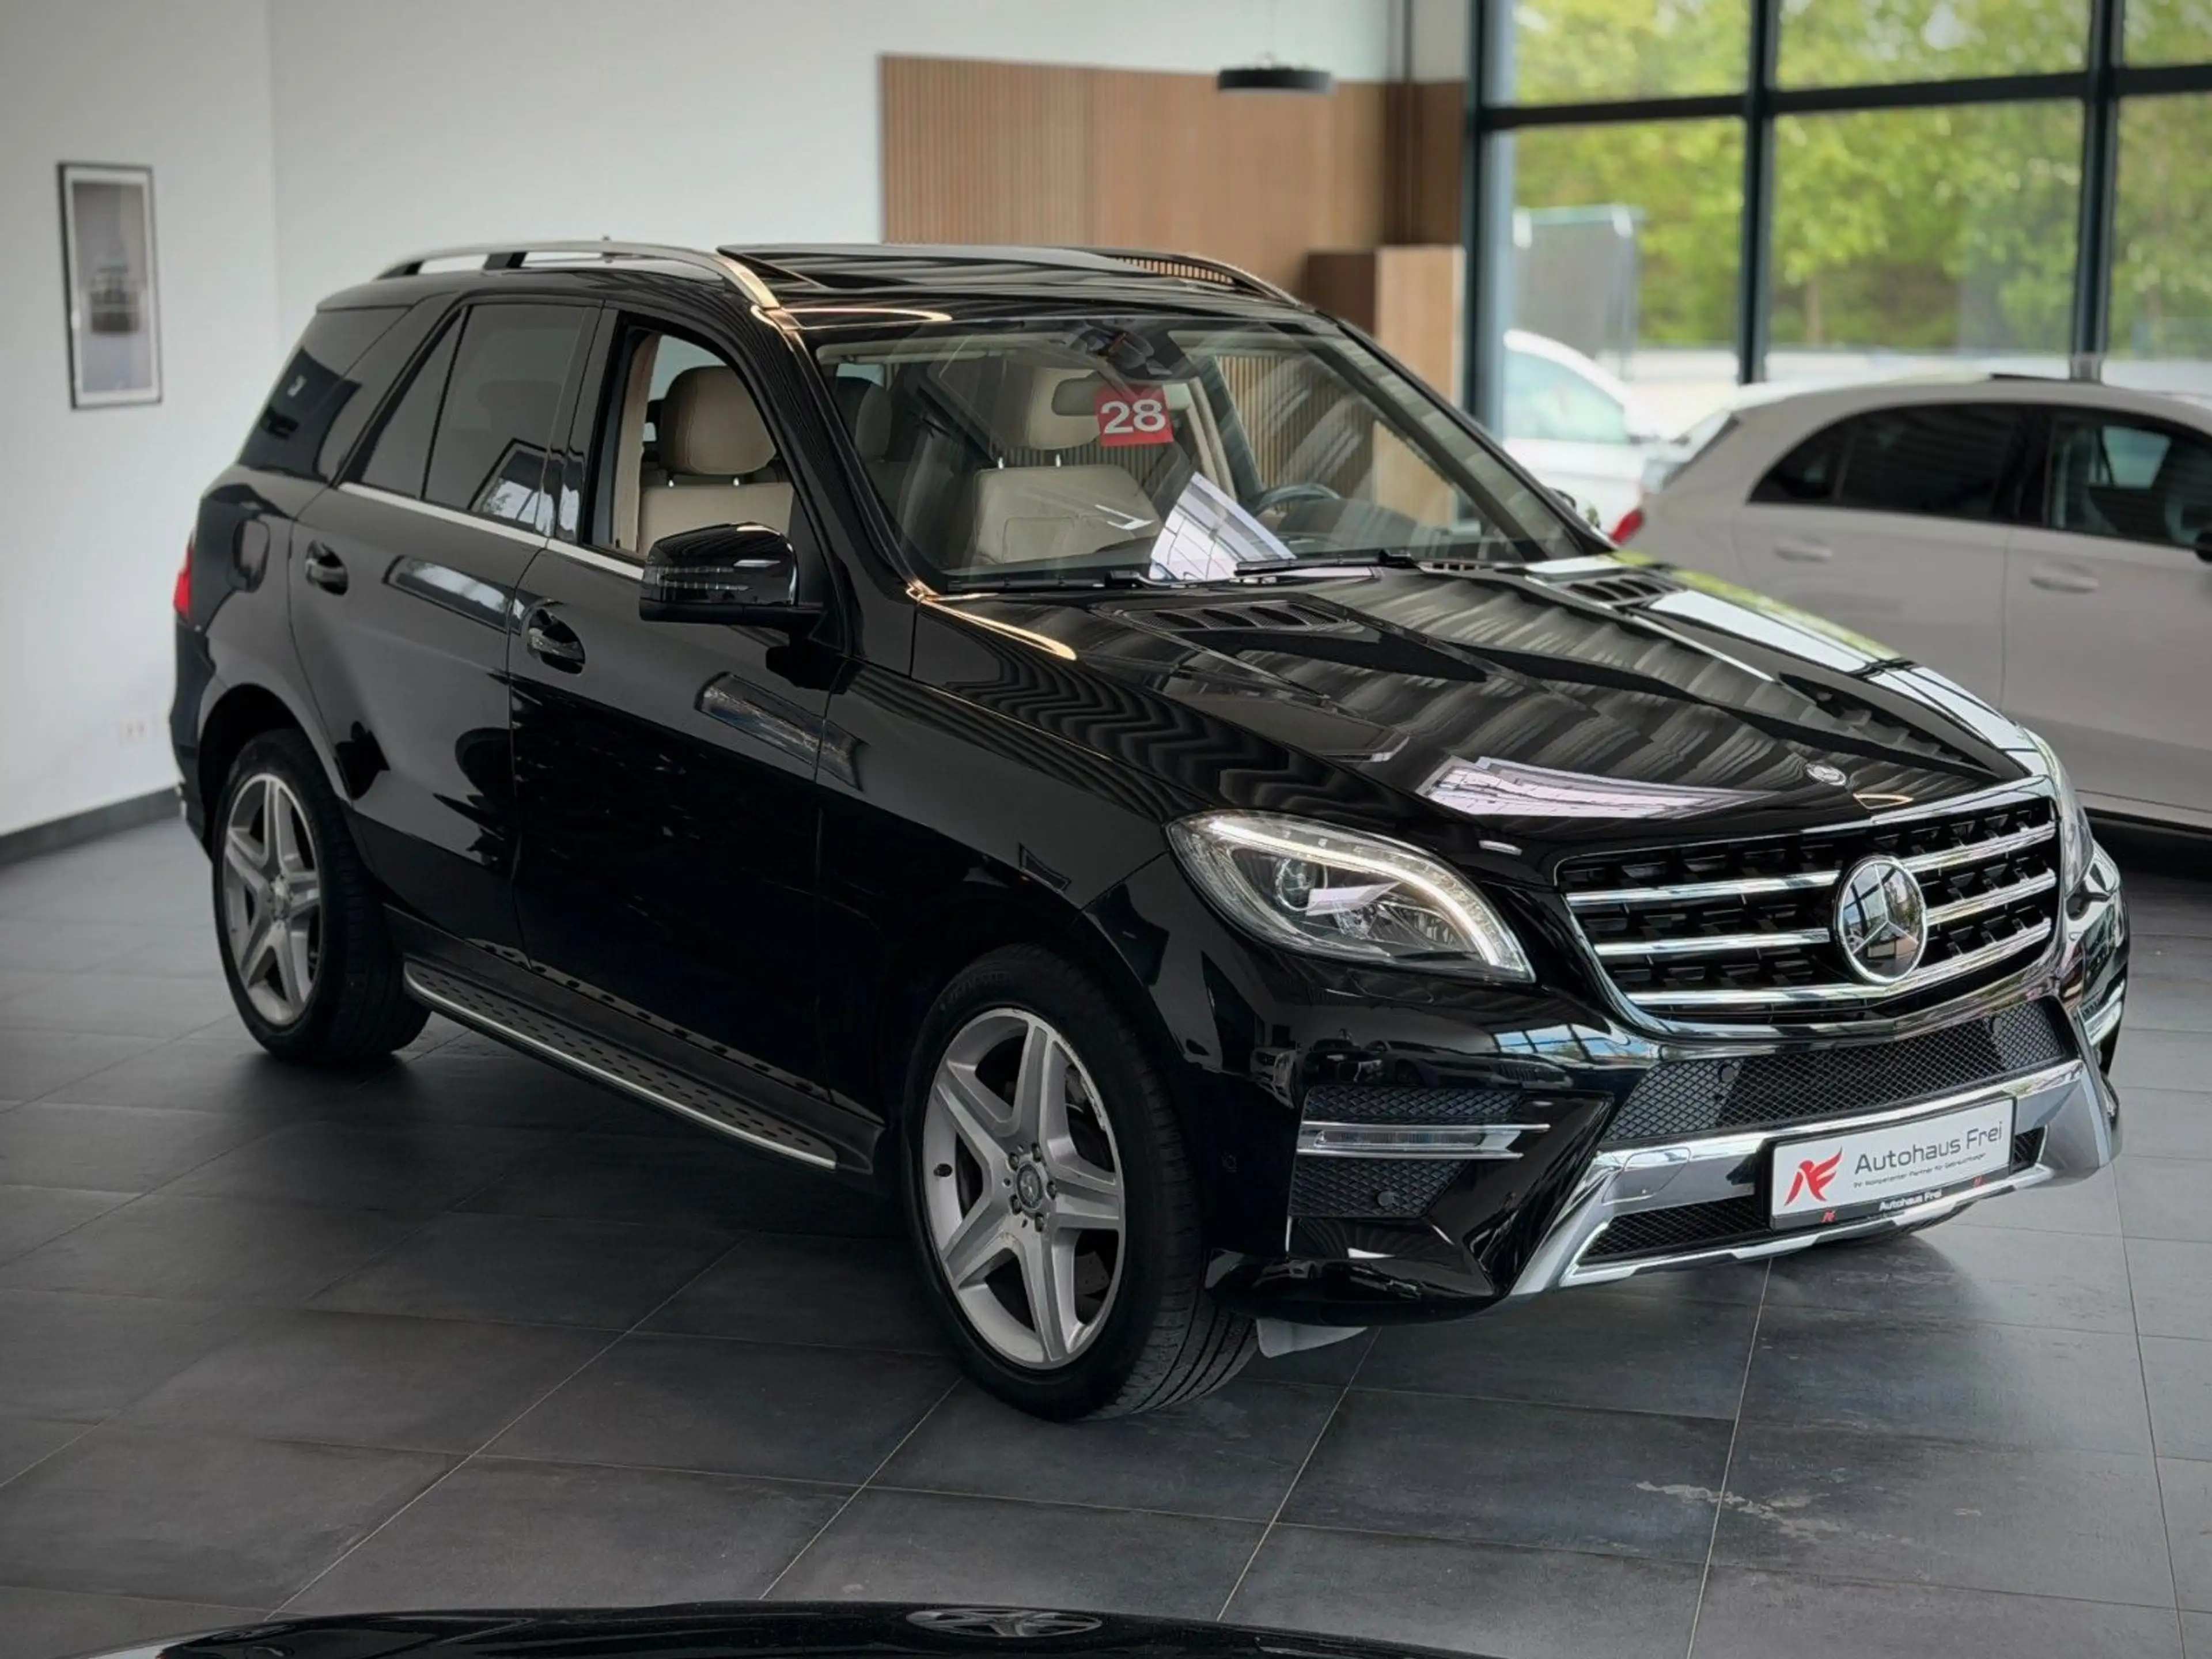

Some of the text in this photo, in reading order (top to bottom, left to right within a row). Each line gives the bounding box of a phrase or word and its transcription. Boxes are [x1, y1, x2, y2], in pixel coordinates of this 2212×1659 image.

[1100, 399, 1166, 434] 28
[1854, 1138, 1961, 1175] Autohaus
[1967, 1121, 2003, 1149] Frei
